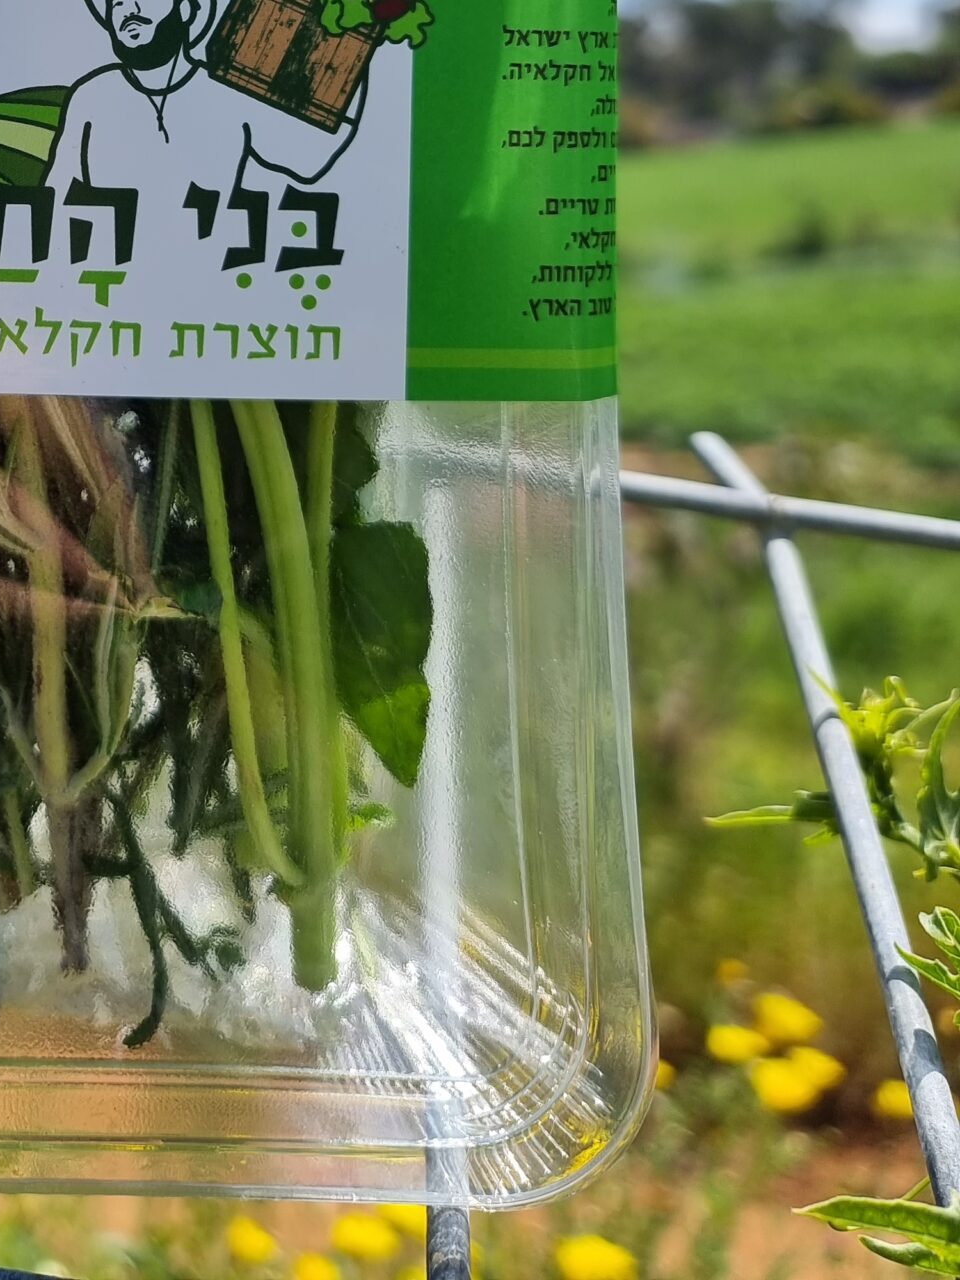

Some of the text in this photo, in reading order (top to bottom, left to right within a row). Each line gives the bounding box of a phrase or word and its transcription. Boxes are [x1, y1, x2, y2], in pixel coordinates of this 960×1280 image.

[502, 25, 570, 47] ישראל
[578, 31, 608, 54] ארץ
[501, 126, 545, 148] לכם,
[553, 127, 606, 153] ולספק
[169, 321, 342, 361] תוצרת
